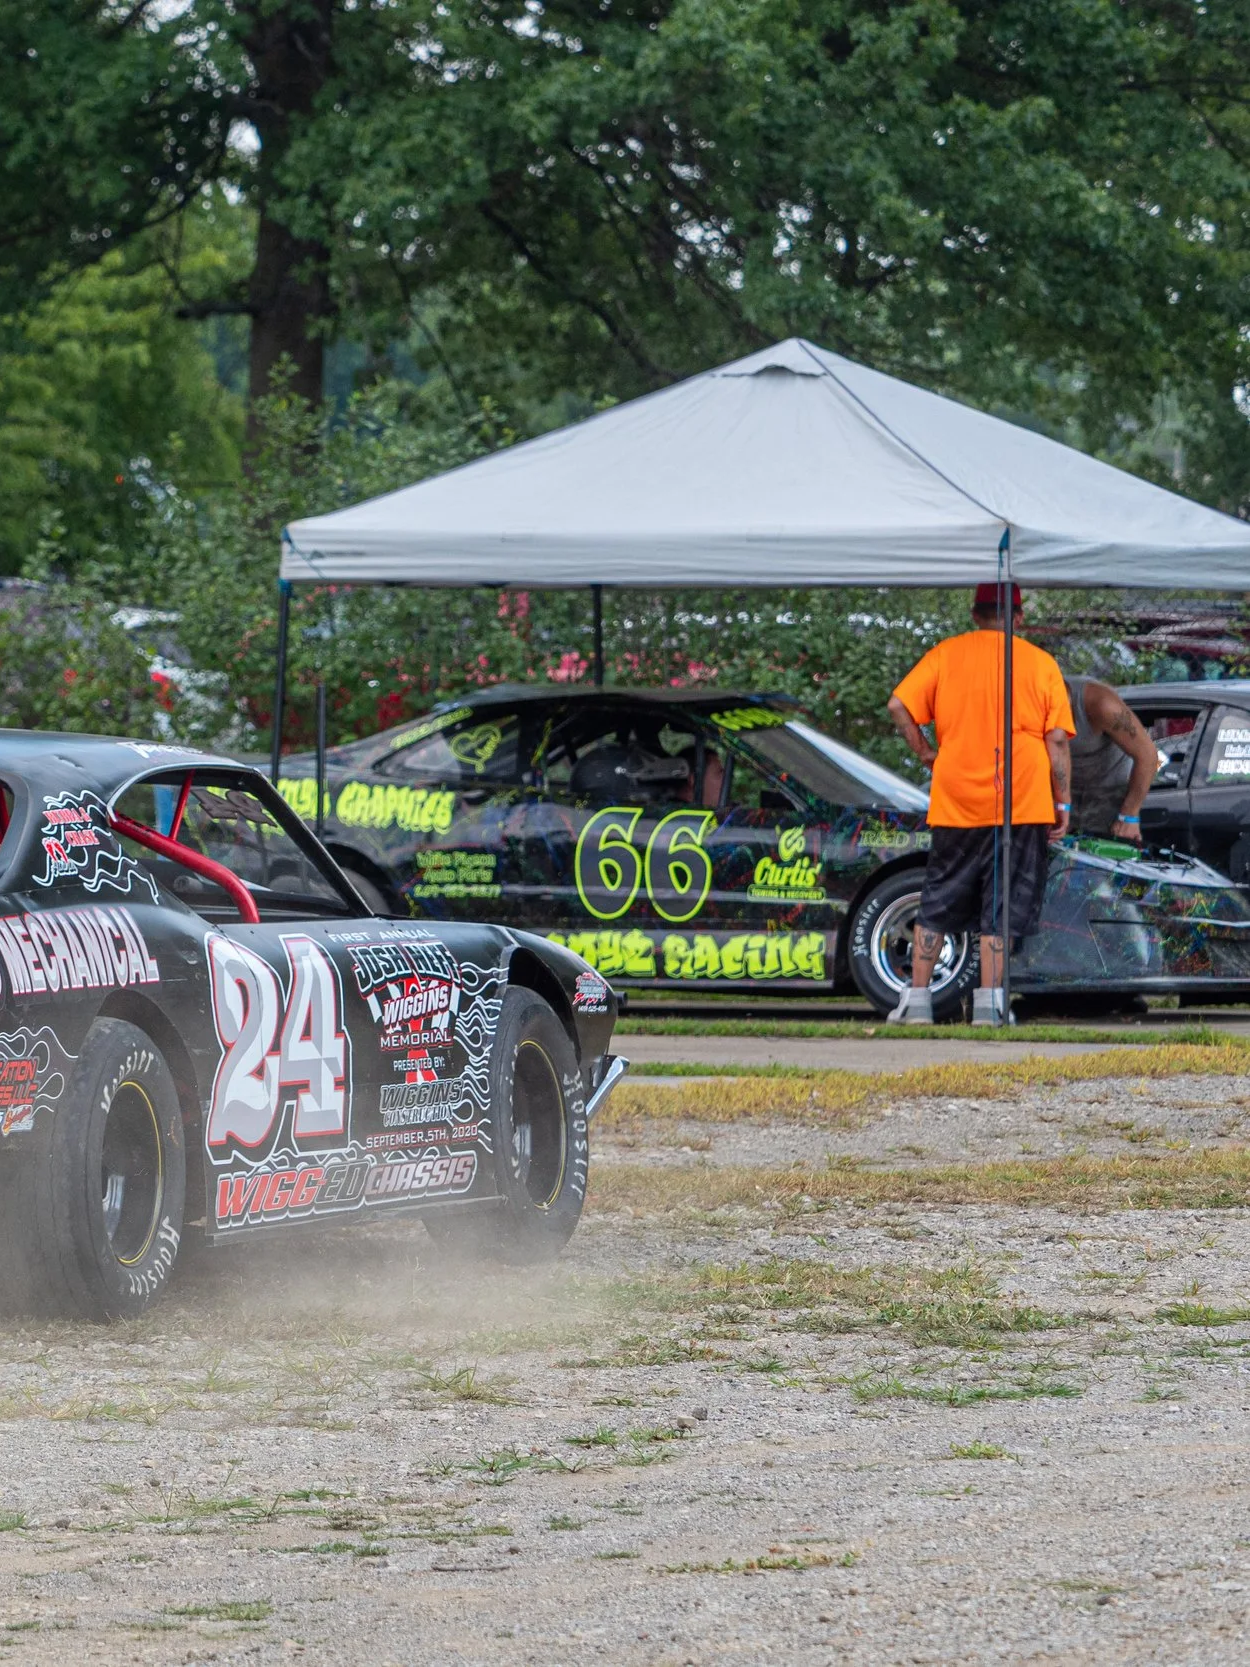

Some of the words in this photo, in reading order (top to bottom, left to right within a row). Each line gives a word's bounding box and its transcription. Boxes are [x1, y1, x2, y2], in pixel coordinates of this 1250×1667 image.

[574, 806, 714, 923] 66
[328, 932, 371, 943] FIRST
[379, 929, 436, 941] ANNUAL
[852, 899, 880, 957] Hoosier
[347, 945, 413, 995] JOSH
[661, 930, 827, 981] RACING
[383, 985, 450, 1028] WIGGINS
[206, 933, 350, 1158] 24
[380, 1031, 452, 1048] MEMORIAL
[393, 1057, 433, 1072] PRESENTED
[434, 1056, 446, 1068] BY:
[380, 1079, 464, 1112] WIGGINS
[383, 1104, 454, 1127] CONSTRUCTION
[366, 1132, 424, 1149] SEPTEMBER
[452, 1125, 478, 1139] 2020
[128, 1216, 181, 1296] Hoosier
